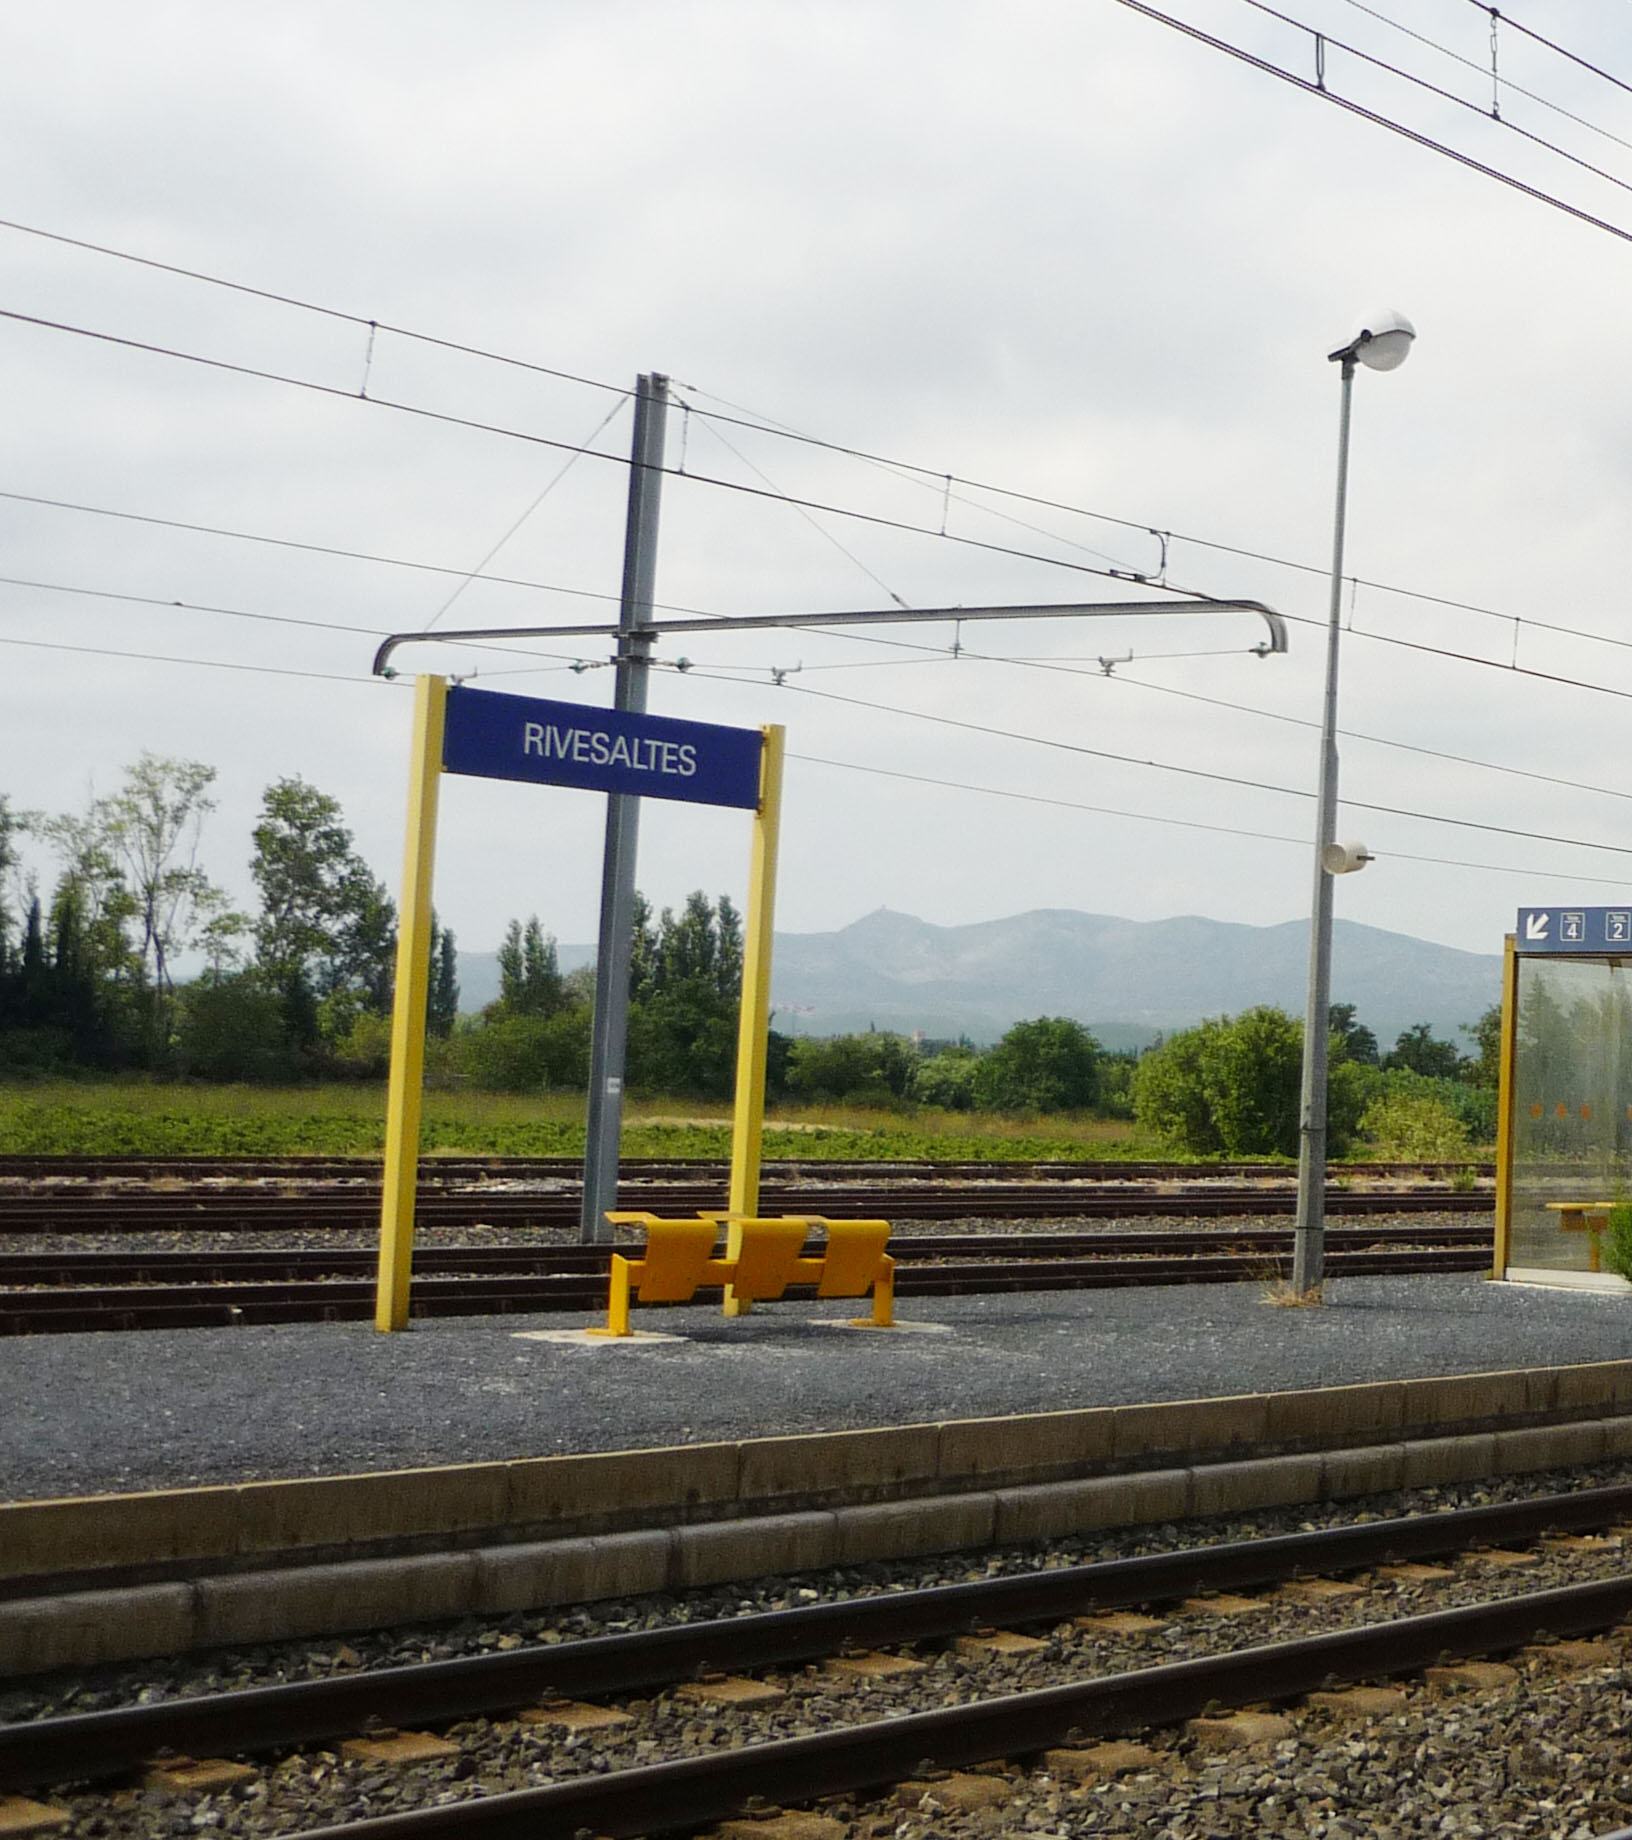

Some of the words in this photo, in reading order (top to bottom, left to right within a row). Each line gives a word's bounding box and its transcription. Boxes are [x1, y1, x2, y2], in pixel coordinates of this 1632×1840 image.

[524, 723, 697, 776] RIVESALTES
[1567, 923, 1578, 939] 4
[1613, 922, 1623, 938] 2
